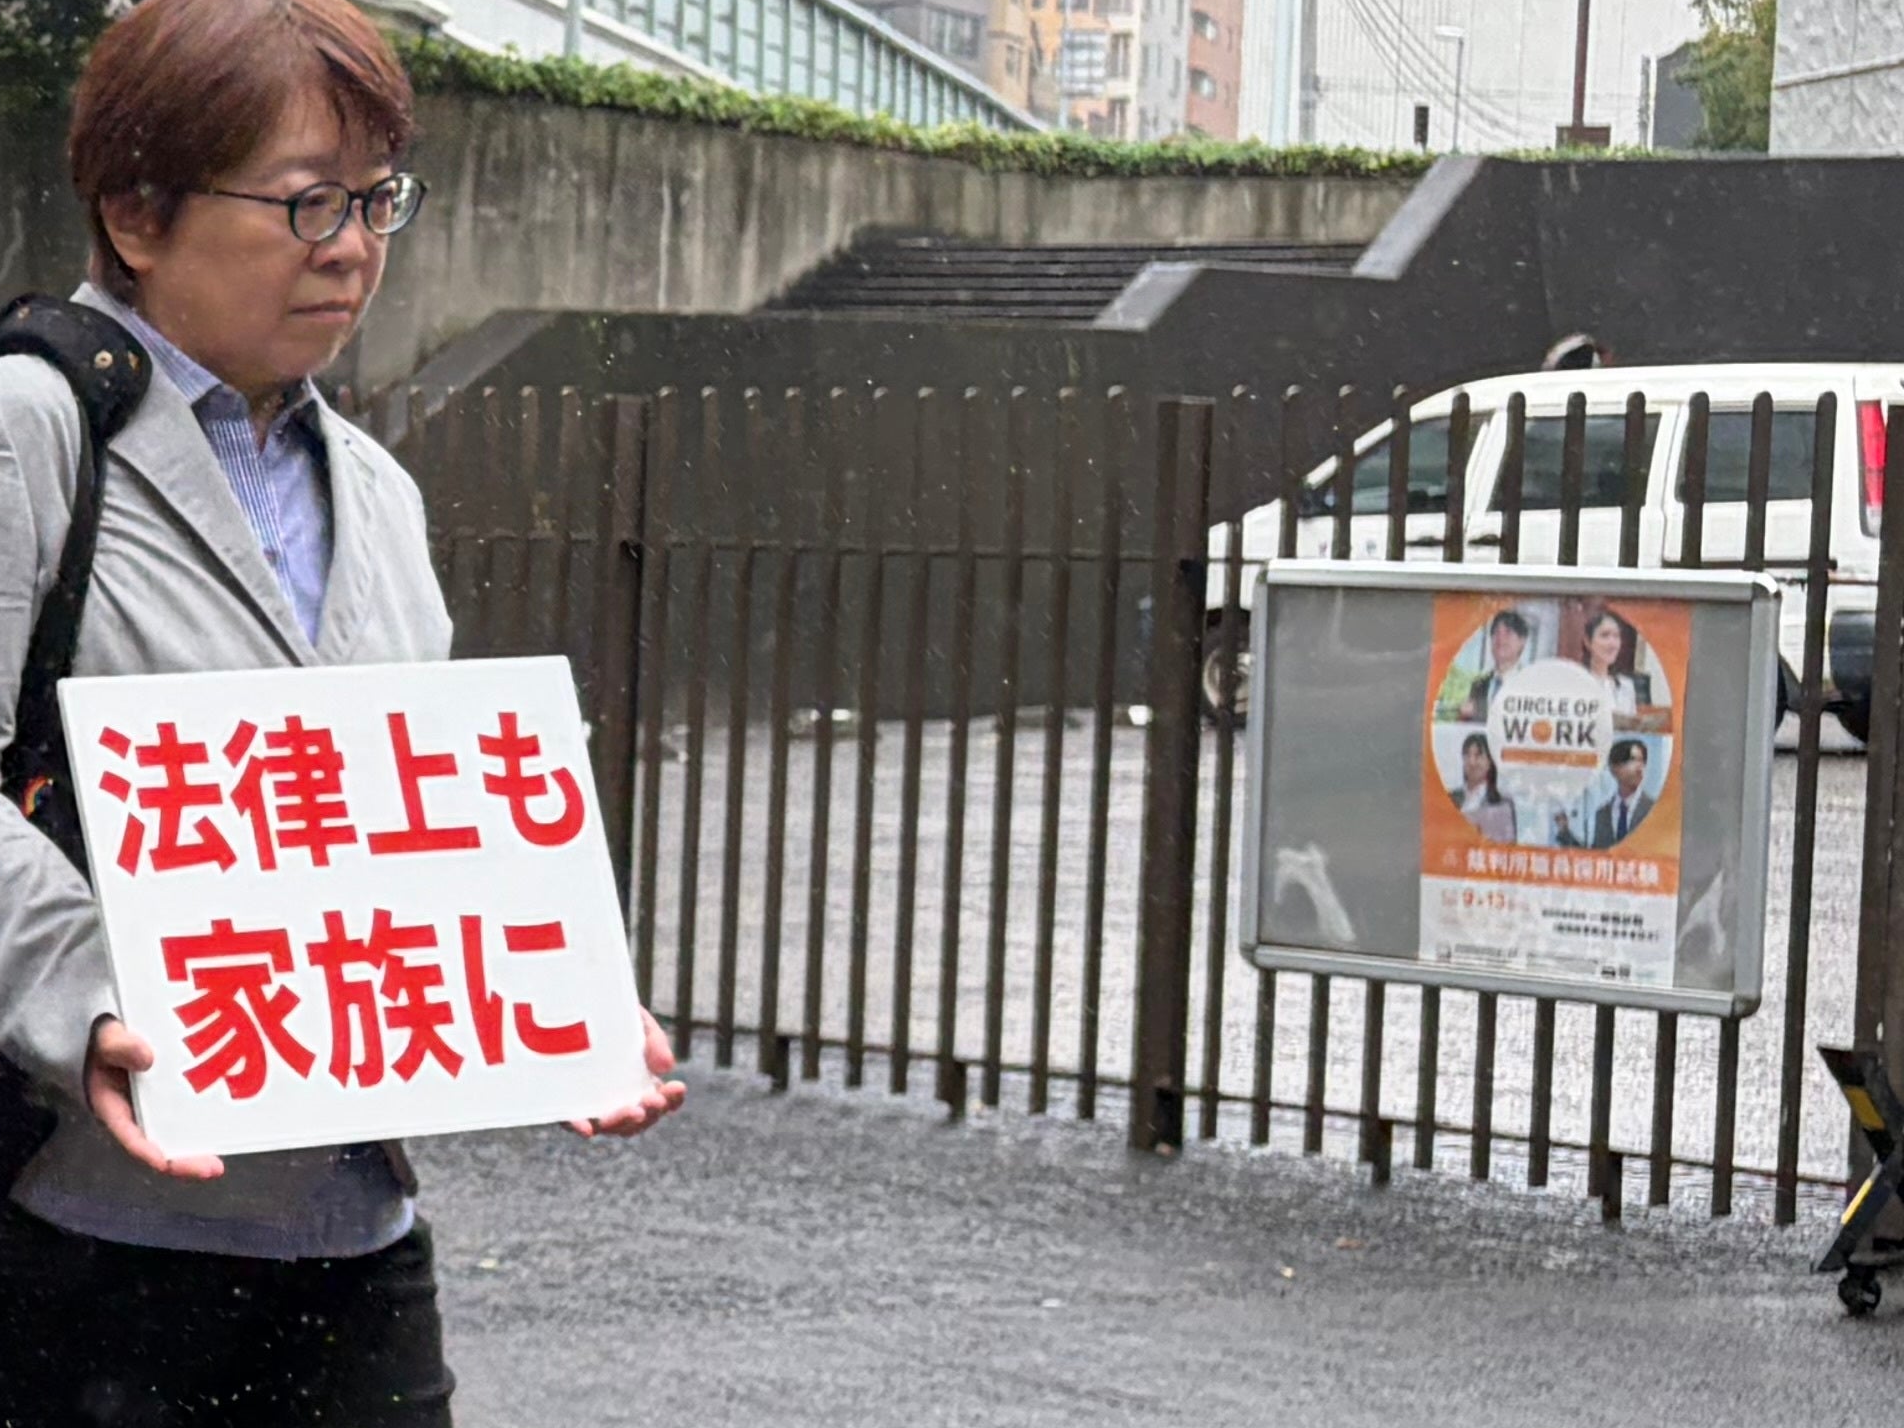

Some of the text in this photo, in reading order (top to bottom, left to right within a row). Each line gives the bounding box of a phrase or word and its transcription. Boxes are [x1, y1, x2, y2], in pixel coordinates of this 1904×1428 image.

[98, 711, 585, 876] 法律上も
[160, 907, 592, 1102] 家族に
